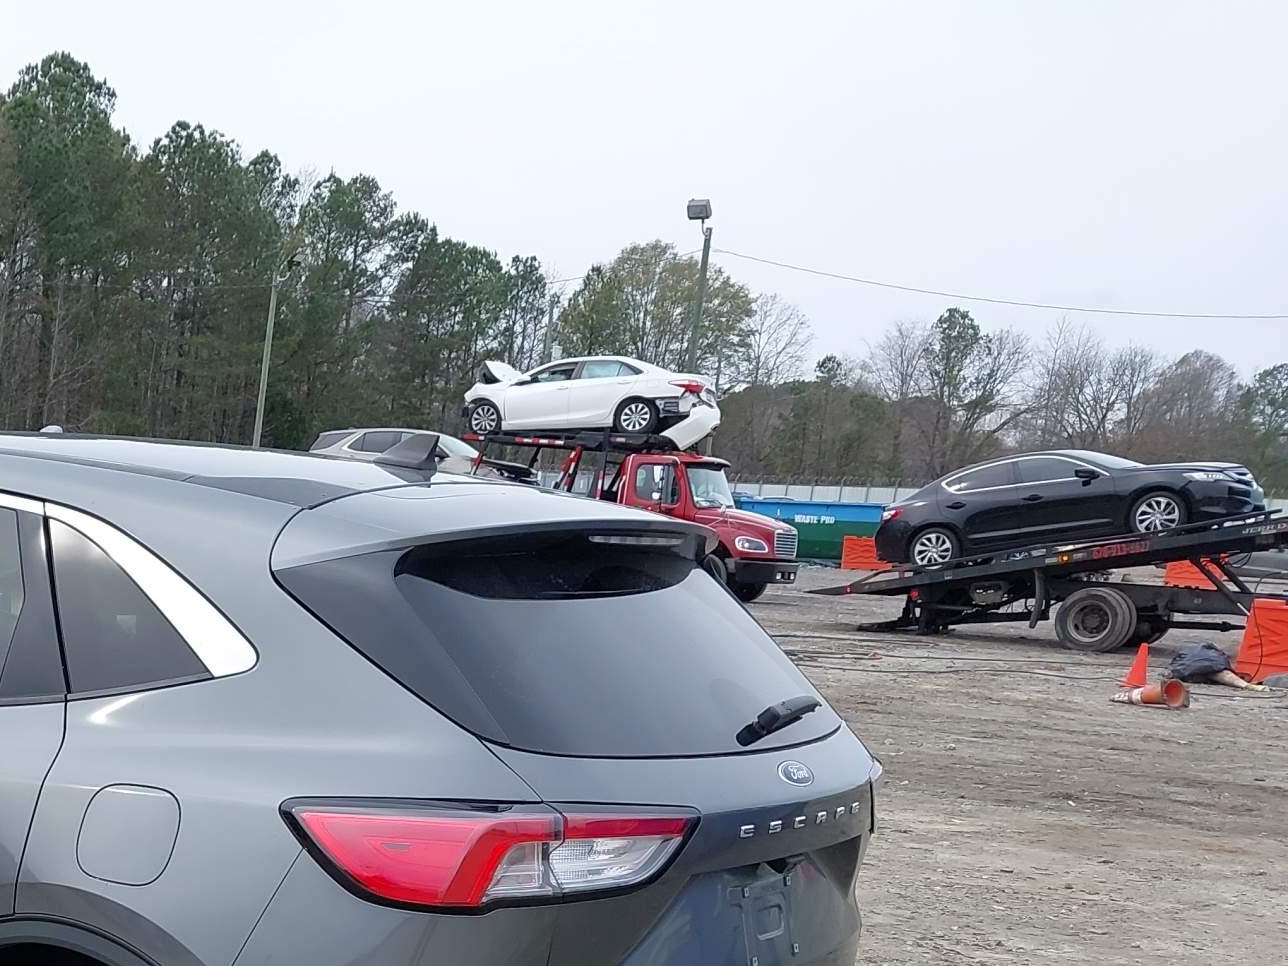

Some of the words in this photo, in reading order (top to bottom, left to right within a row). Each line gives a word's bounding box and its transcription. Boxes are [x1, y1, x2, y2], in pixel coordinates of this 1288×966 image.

[794, 514, 818, 524] WASTE
[820, 515, 836, 524] PRO
[740, 802, 860, 838] ESCAPE
